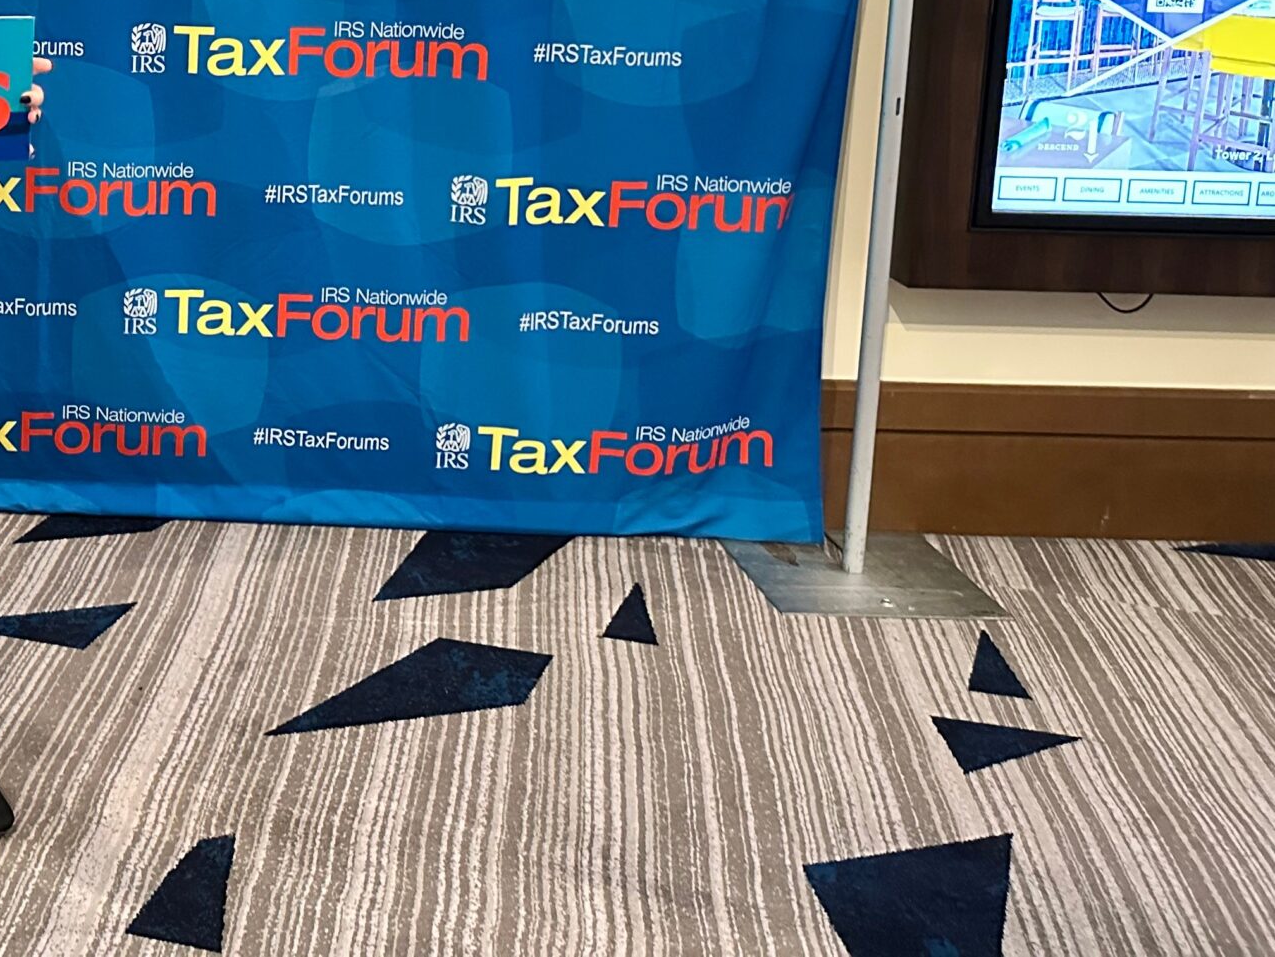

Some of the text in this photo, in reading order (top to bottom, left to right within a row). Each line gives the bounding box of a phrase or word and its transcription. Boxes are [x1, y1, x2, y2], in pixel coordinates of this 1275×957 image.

[334, 21, 465, 41] IRS Nationwide
[131, 52, 166, 74] IRS
[174, 25, 489, 81] TaxForum
[533, 43, 682, 67] #IRSTaxForums
[67, 161, 194, 179] IRS Nationwide
[264, 184, 404, 206] #IRSTaxForums
[656, 174, 792, 195] IRS Nationwide
[450, 203, 486, 225] IRS
[321, 287, 448, 306] IRS Nationwide
[124, 315, 157, 335] IRS
[164, 289, 470, 343] TaxForum
[519, 310, 659, 335] #IRSTaxForums
[62, 404, 185, 424] IRS Nationwide
[253, 427, 390, 451] #IRSTaxForums
[635, 416, 750, 443] IRS Nationwide
[435, 449, 469, 470] IRS
[478, 426, 774, 476] TaxForum
